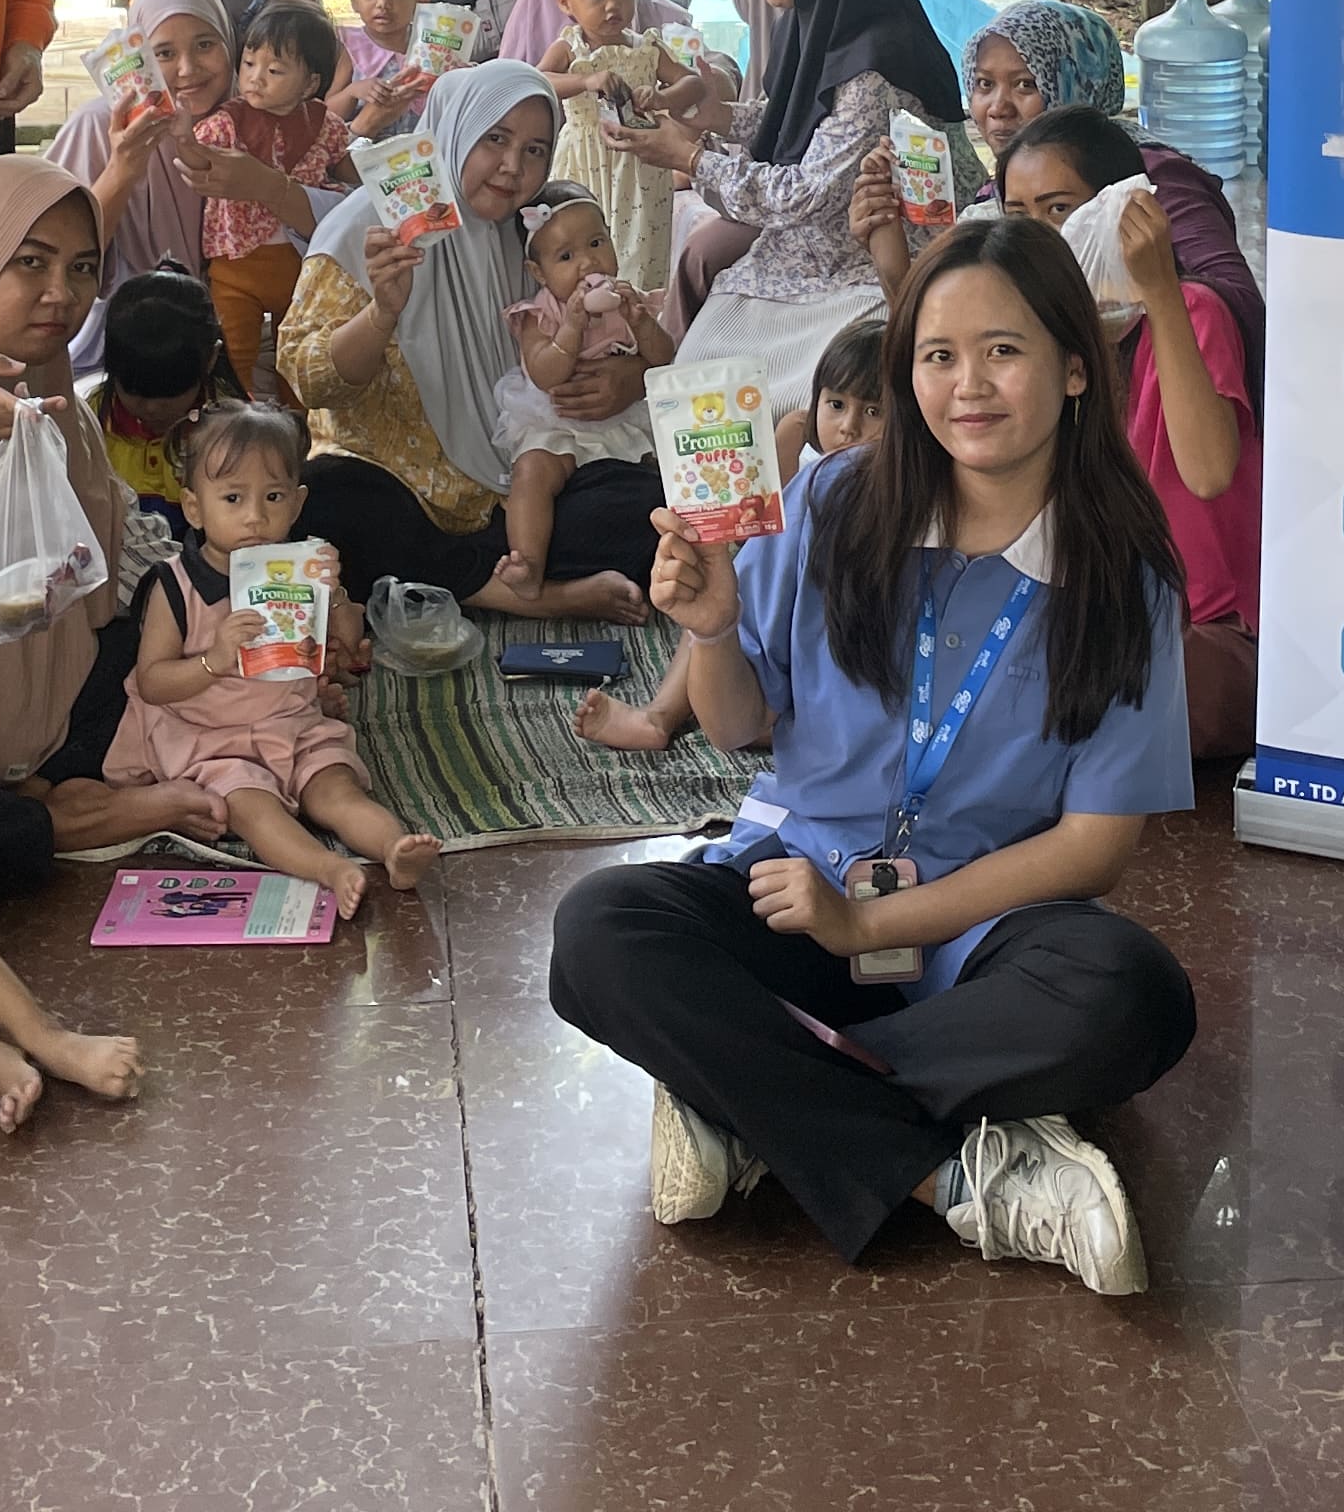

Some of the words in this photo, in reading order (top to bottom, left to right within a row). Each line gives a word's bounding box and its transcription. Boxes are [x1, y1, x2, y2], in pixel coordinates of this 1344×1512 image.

[383, 167, 430, 193] Promina
[676, 429, 750, 453] Promina
[249, 588, 311, 602] Promina
[1273, 776, 1305, 798] PT.
[1309, 779, 1336, 801] TD
